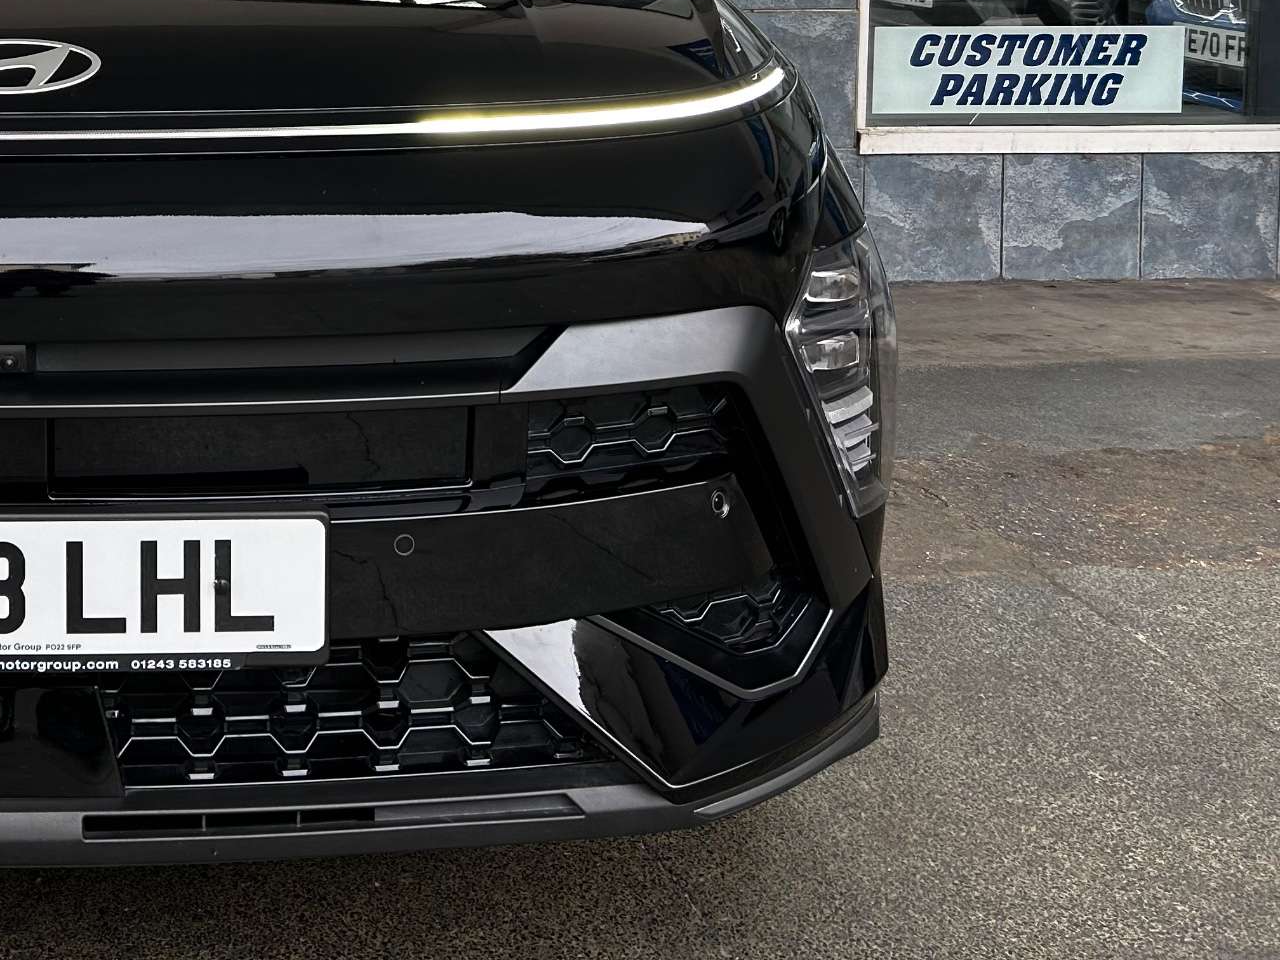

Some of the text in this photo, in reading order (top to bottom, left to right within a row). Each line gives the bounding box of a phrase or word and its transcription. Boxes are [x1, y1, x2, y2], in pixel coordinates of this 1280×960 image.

[909, 33, 1148, 67] CUSTOMER
[930, 73, 1125, 106] PARKING
[66, 539, 275, 633] LHL
[13, 642, 42, 652] Group
[45, 643, 65, 651] PO22
[131, 659, 174, 670] 01243
[178, 658, 231, 669] 583185
